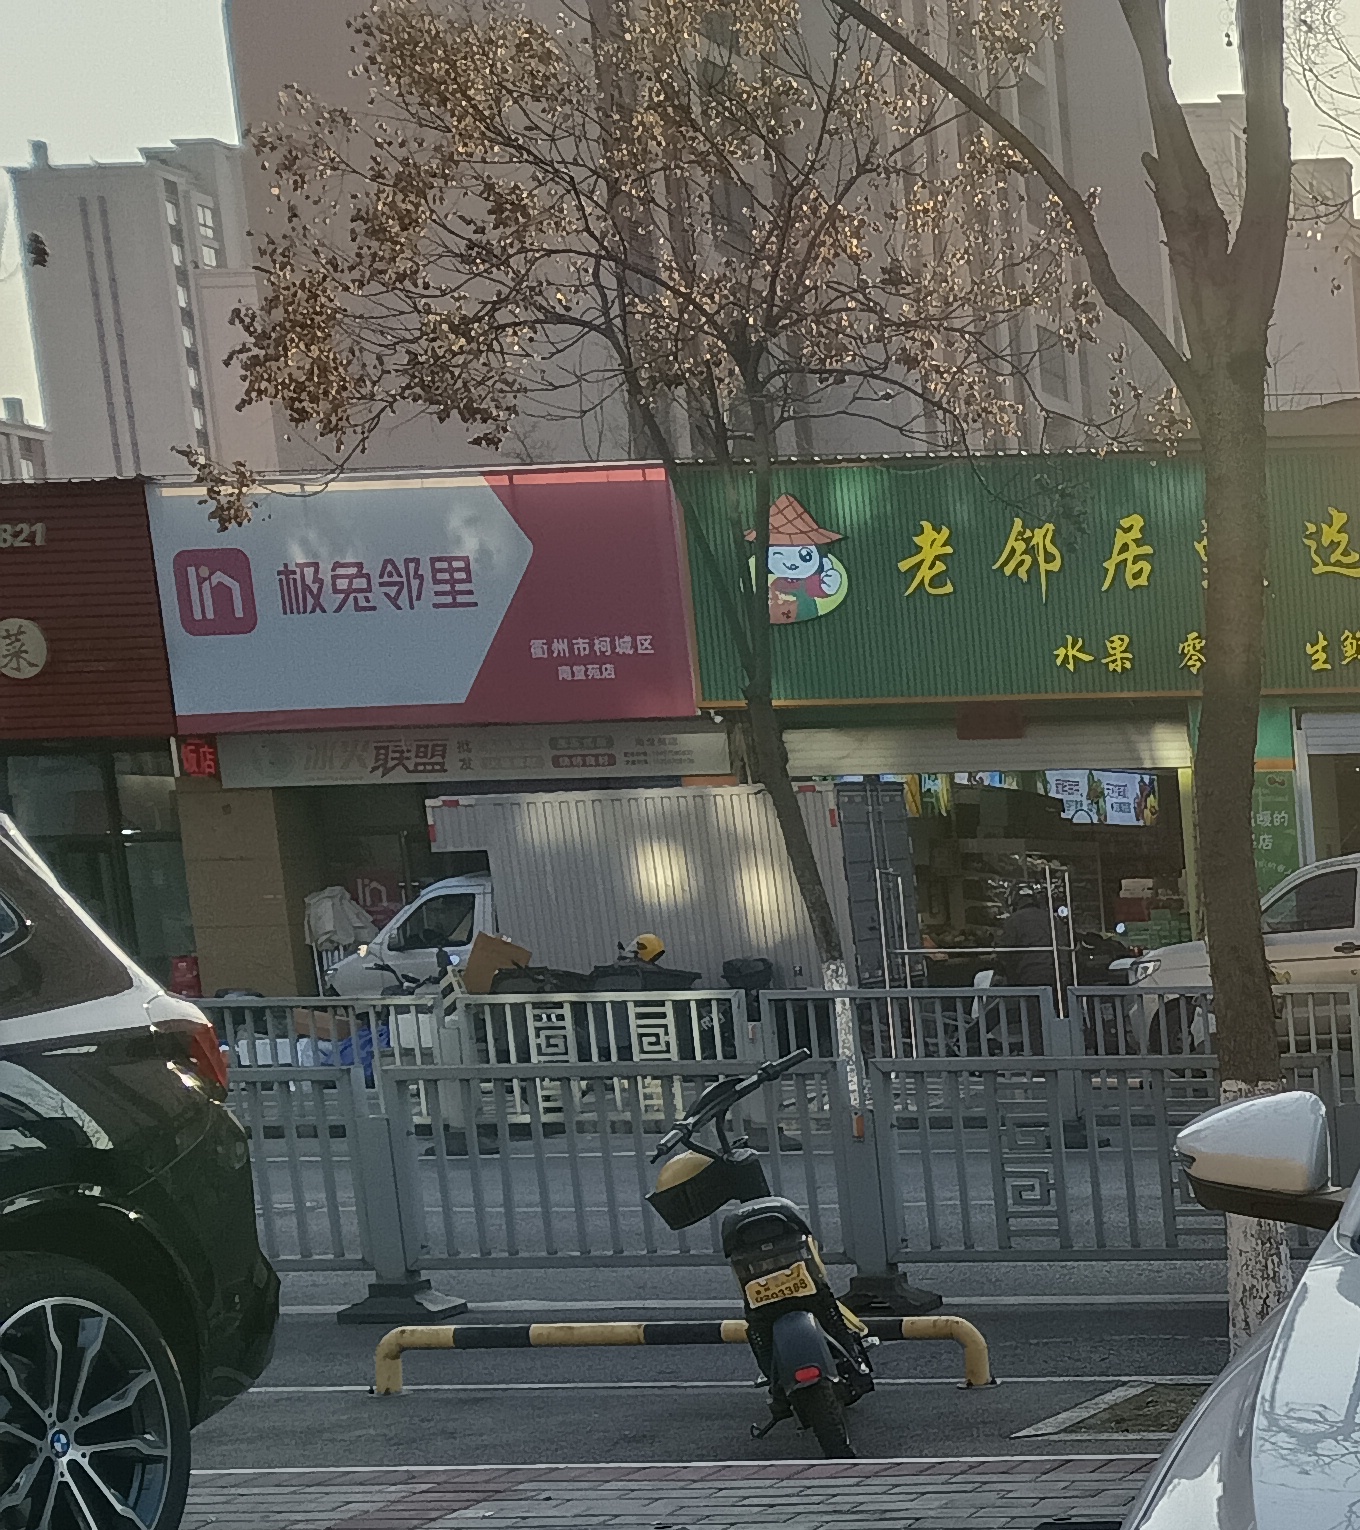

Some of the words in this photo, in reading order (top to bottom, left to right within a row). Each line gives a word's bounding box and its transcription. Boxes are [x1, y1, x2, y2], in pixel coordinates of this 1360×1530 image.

[277, 555, 478, 615] 极兔邻里
[0, 624, 39, 673] 菜
[530, 635, 654, 658] 衢州市柯城区
[1053, 634, 1133, 673] 水果
[1178, 632, 1207, 674] 零
[1251, 811, 1289, 828] 暖的
